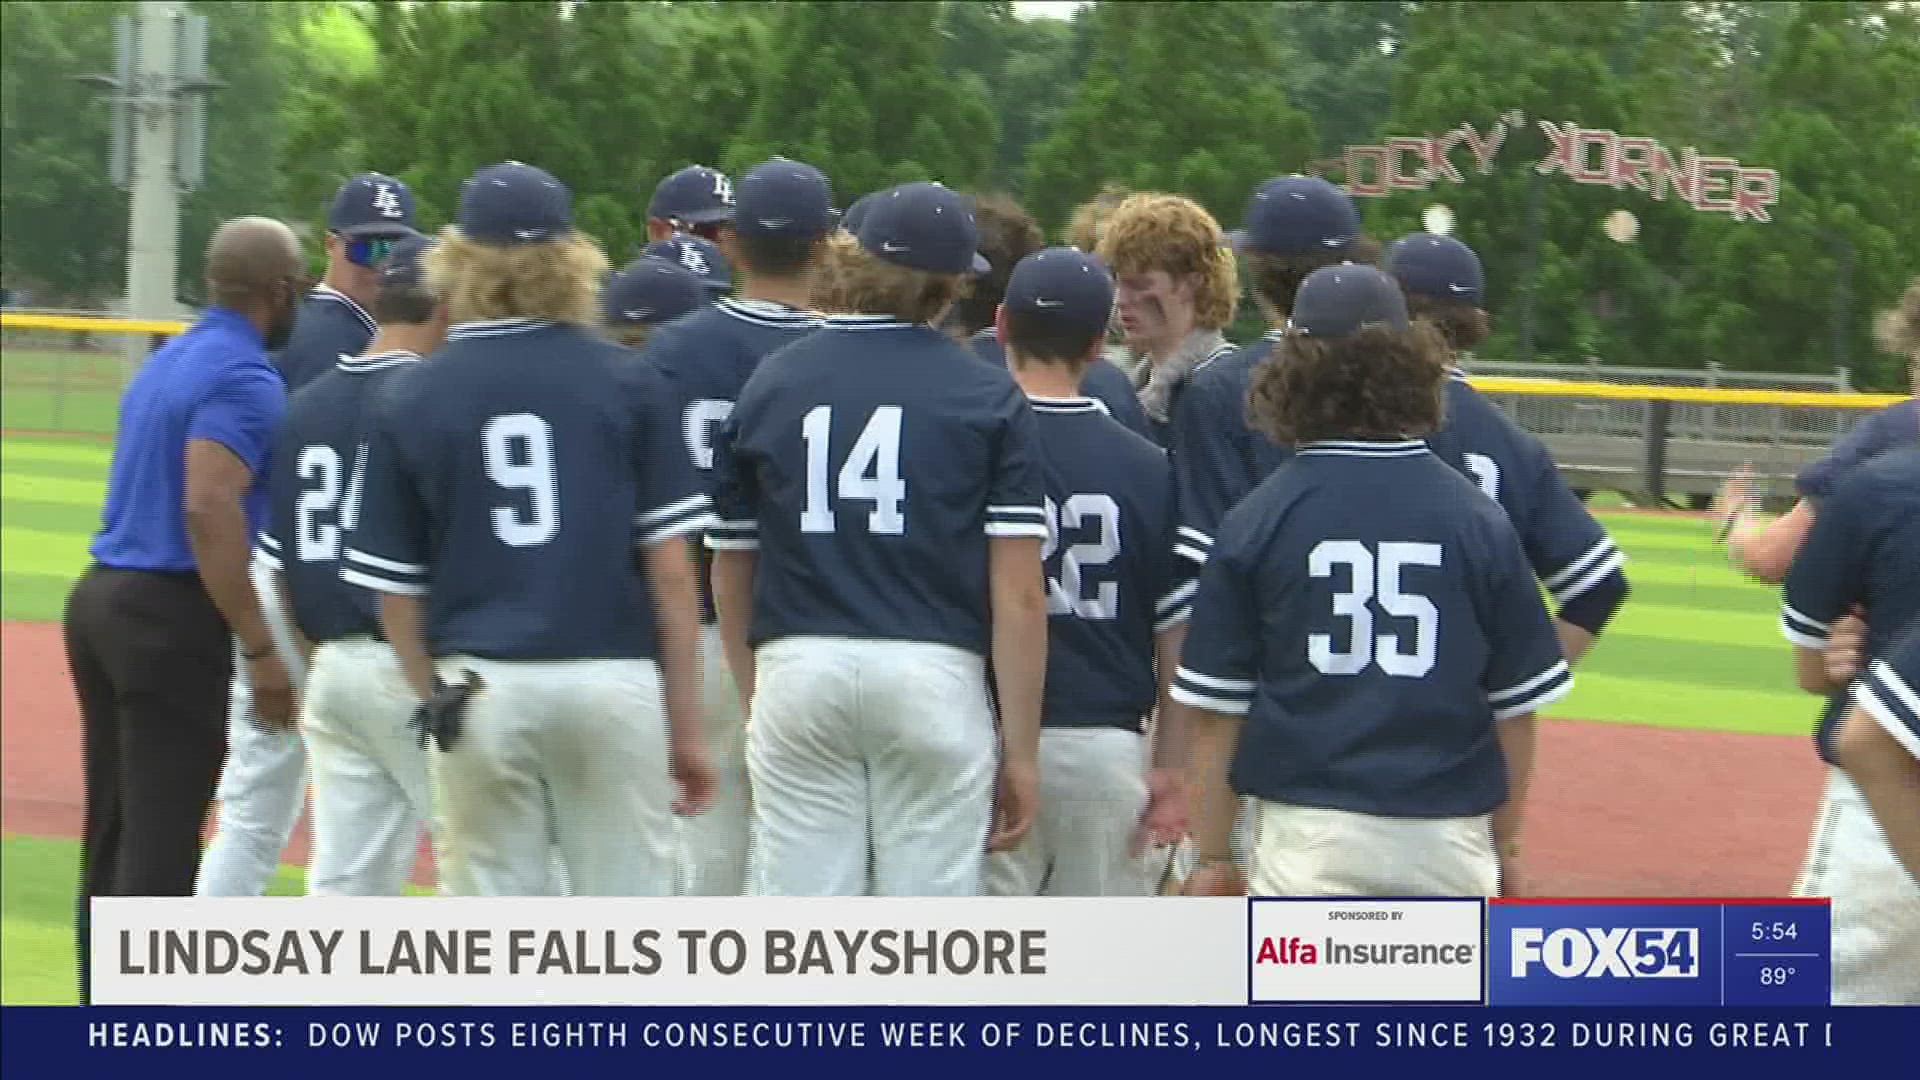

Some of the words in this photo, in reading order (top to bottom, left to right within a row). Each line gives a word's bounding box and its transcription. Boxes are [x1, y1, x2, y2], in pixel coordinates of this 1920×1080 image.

[481, 413, 560, 547] 9
[801, 405, 906, 535] 14
[1307, 541, 1443, 677] 35
